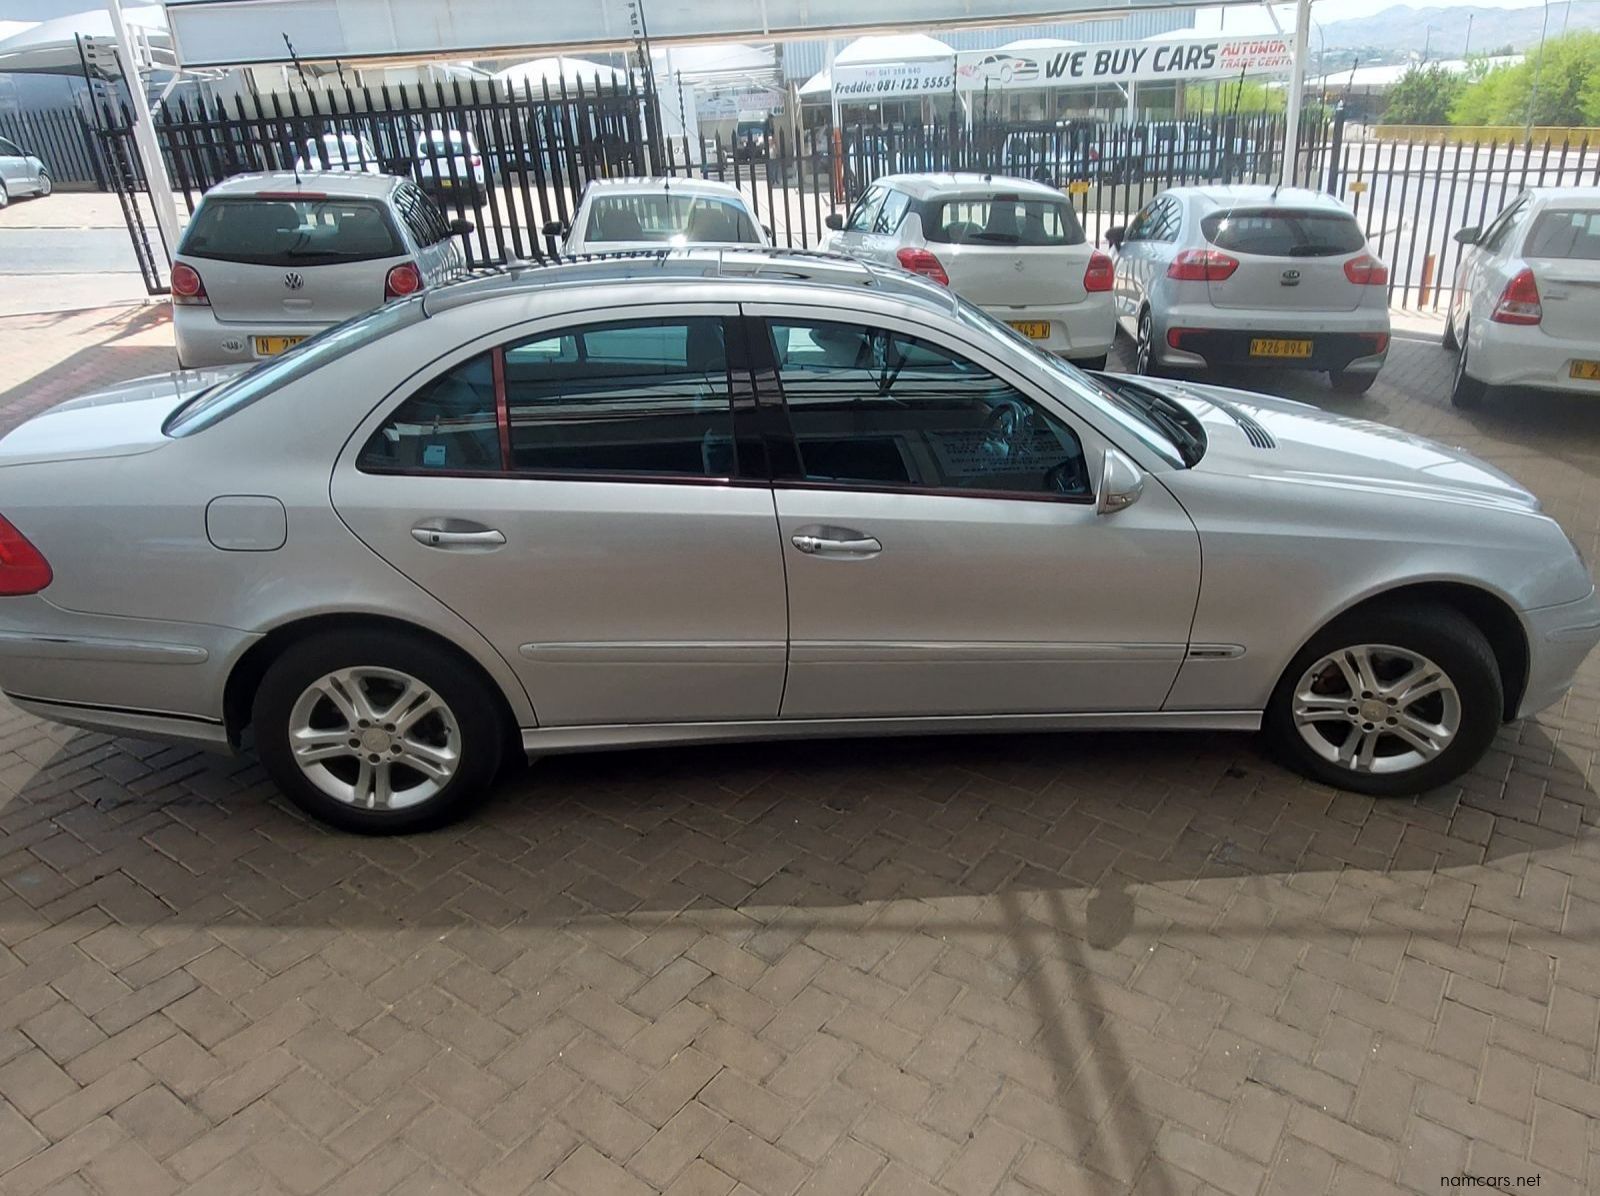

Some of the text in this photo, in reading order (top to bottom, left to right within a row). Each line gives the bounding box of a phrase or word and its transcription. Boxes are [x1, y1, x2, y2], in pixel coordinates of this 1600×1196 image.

[1046, 43, 1218, 78] WE BUY CARS
[835, 75, 951, 94] Freddie: 081-122 5555
[261, 338, 270, 353] N
